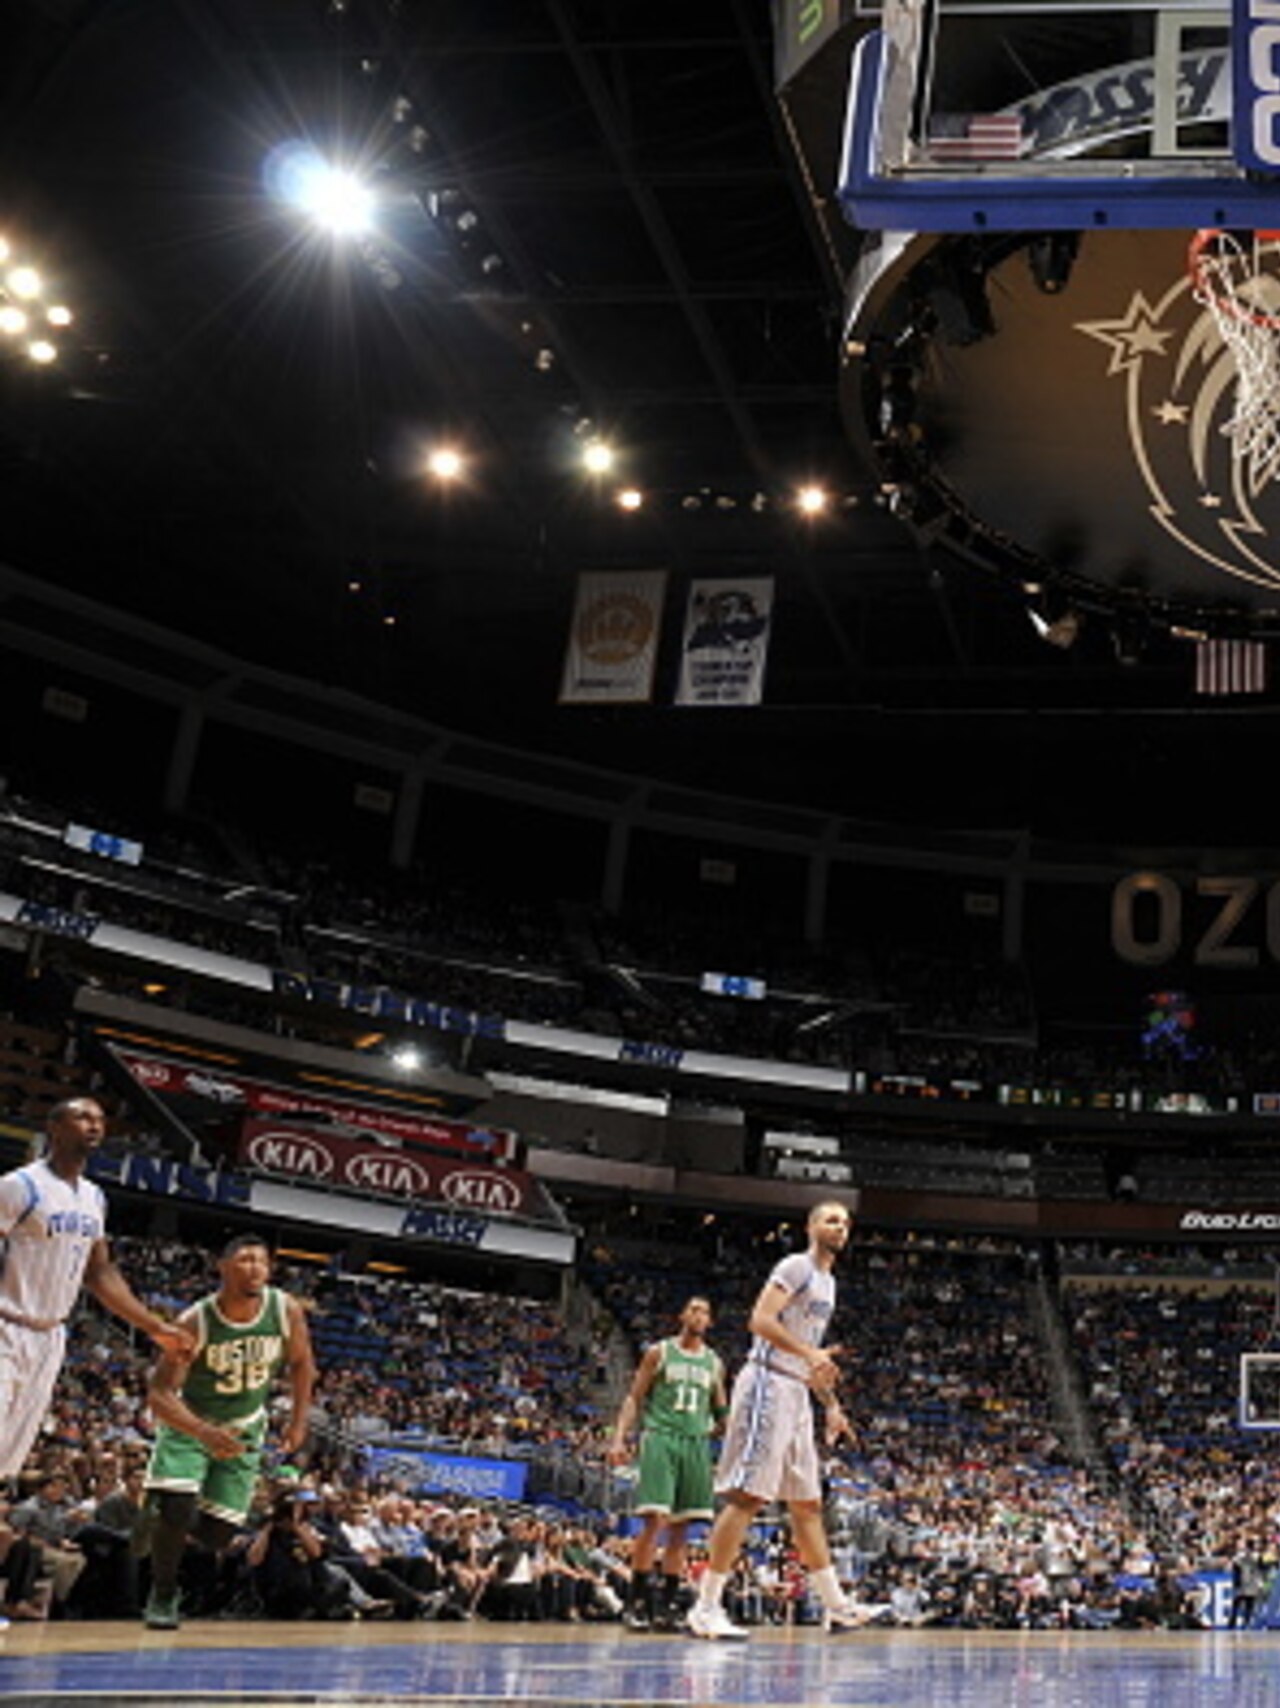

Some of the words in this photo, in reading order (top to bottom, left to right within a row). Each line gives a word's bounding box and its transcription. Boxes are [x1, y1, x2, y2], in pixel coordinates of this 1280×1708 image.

[263, 1140, 318, 1177] KIA
[360, 1157, 412, 1191] KIA
[454, 1175, 507, 1208] KIA
[207, 1336, 282, 1372] BOSTON
[673, 1384, 699, 1413] 11
